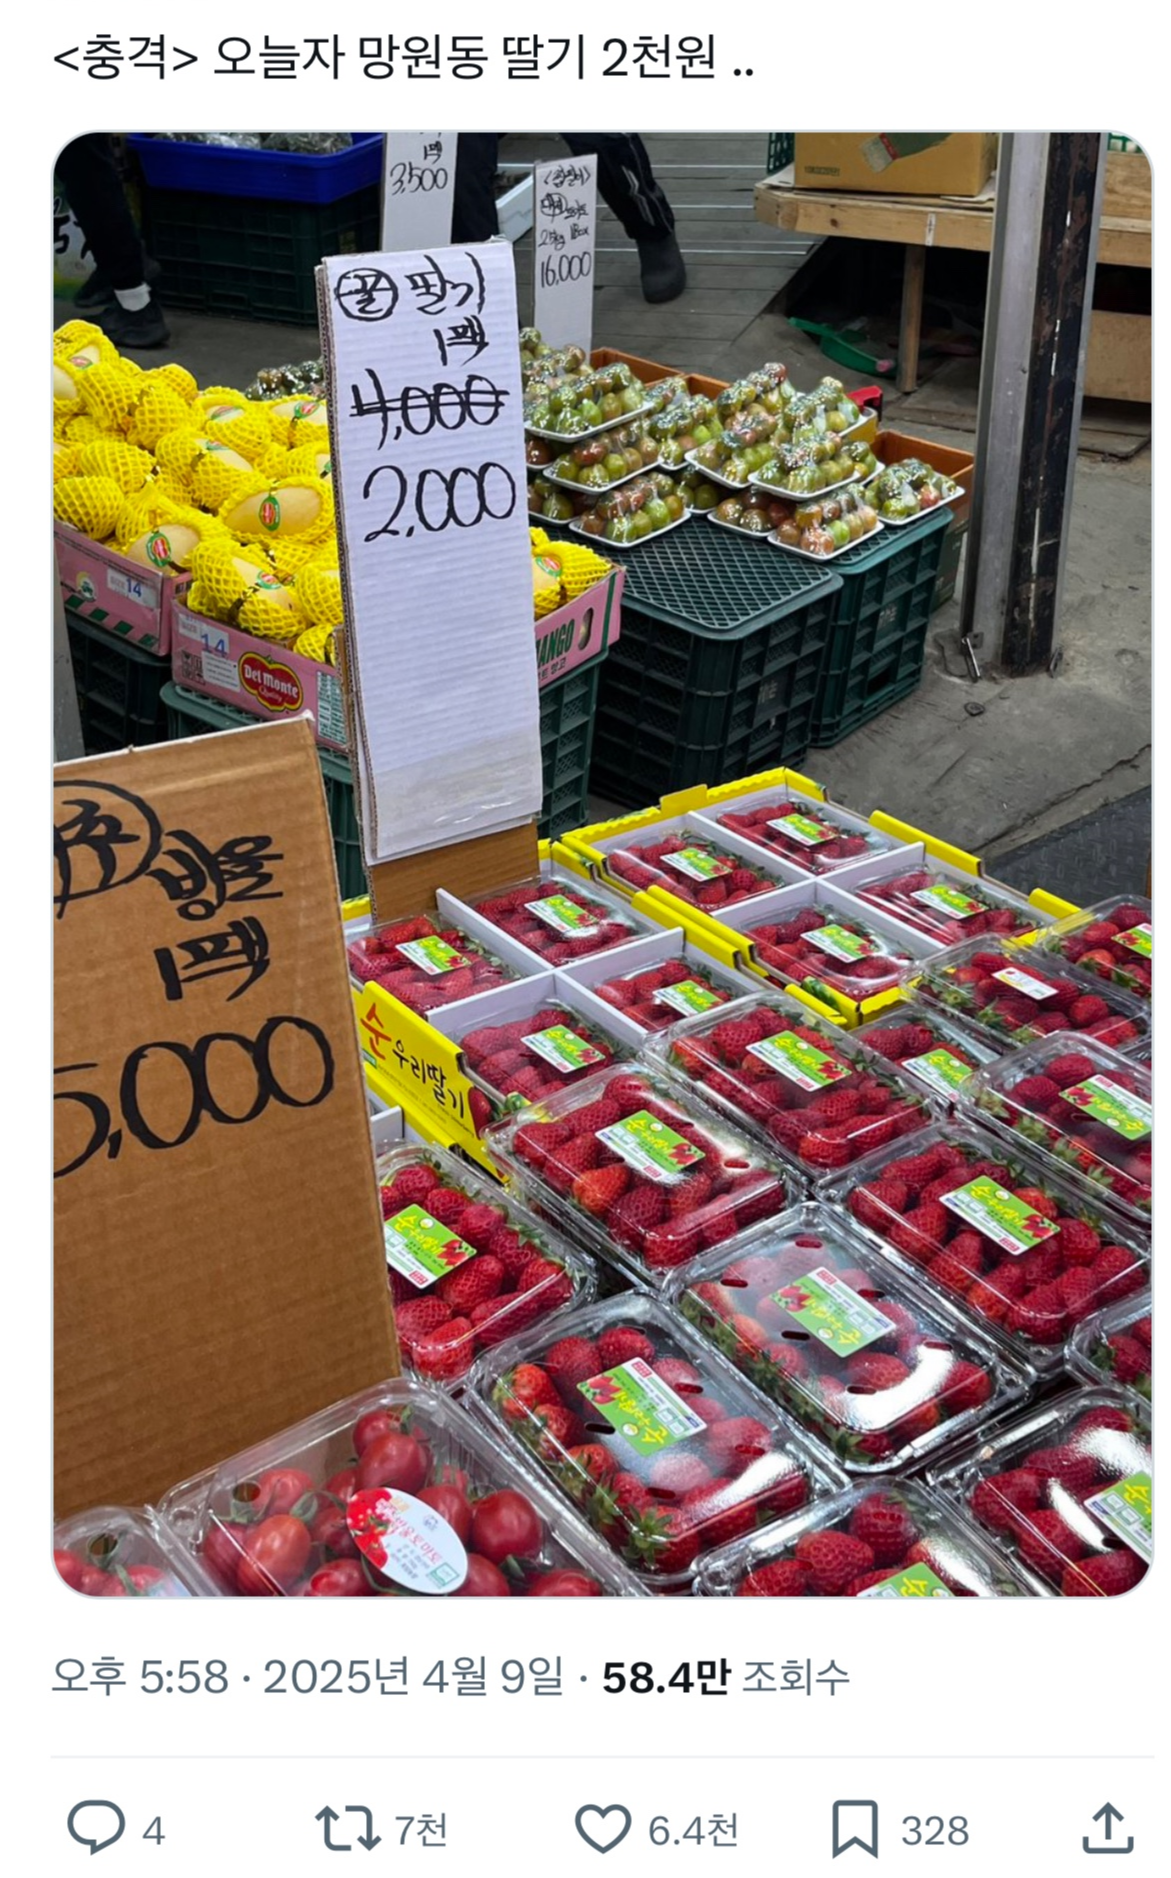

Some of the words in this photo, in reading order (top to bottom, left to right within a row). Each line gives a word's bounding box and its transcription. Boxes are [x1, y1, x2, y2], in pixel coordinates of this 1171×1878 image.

[390, 161, 448, 196] 3,500
[404, 251, 486, 315] 딸기
[541, 251, 592, 289] 16,000
[362, 461, 517, 543] 2,000
[126, 577, 142, 598] 14
[201, 633, 229, 658] 14
[243, 664, 262, 684] Del
[263, 672, 299, 699] Monte
[360, 1002, 393, 1061] 순
[392, 1039, 465, 1119] 우리딸기
[54, 1015, 336, 1180] 5,000
